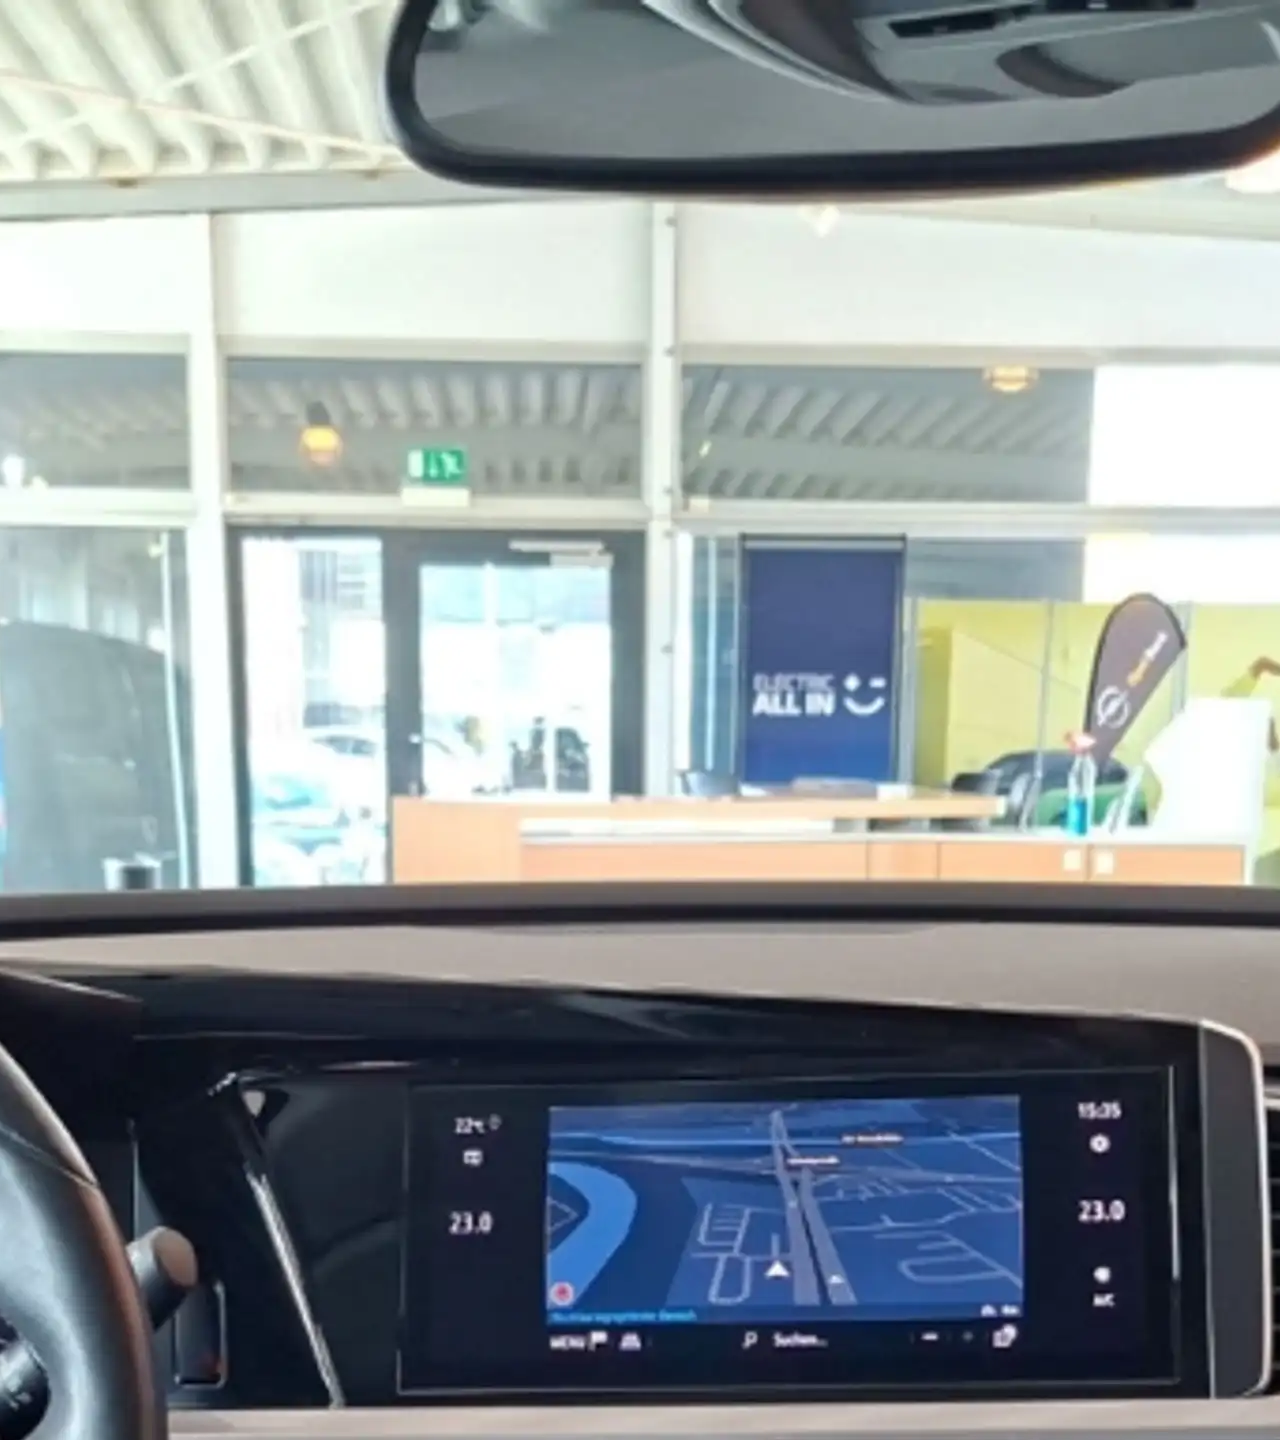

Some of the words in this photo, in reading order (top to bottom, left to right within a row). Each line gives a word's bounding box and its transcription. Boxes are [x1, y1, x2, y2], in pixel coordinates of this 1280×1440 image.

[752, 692, 802, 717] ALL
[805, 691, 835, 716] IN
[1078, 1199, 1125, 1222] 23.0
[448, 1211, 493, 1235] 23.0
